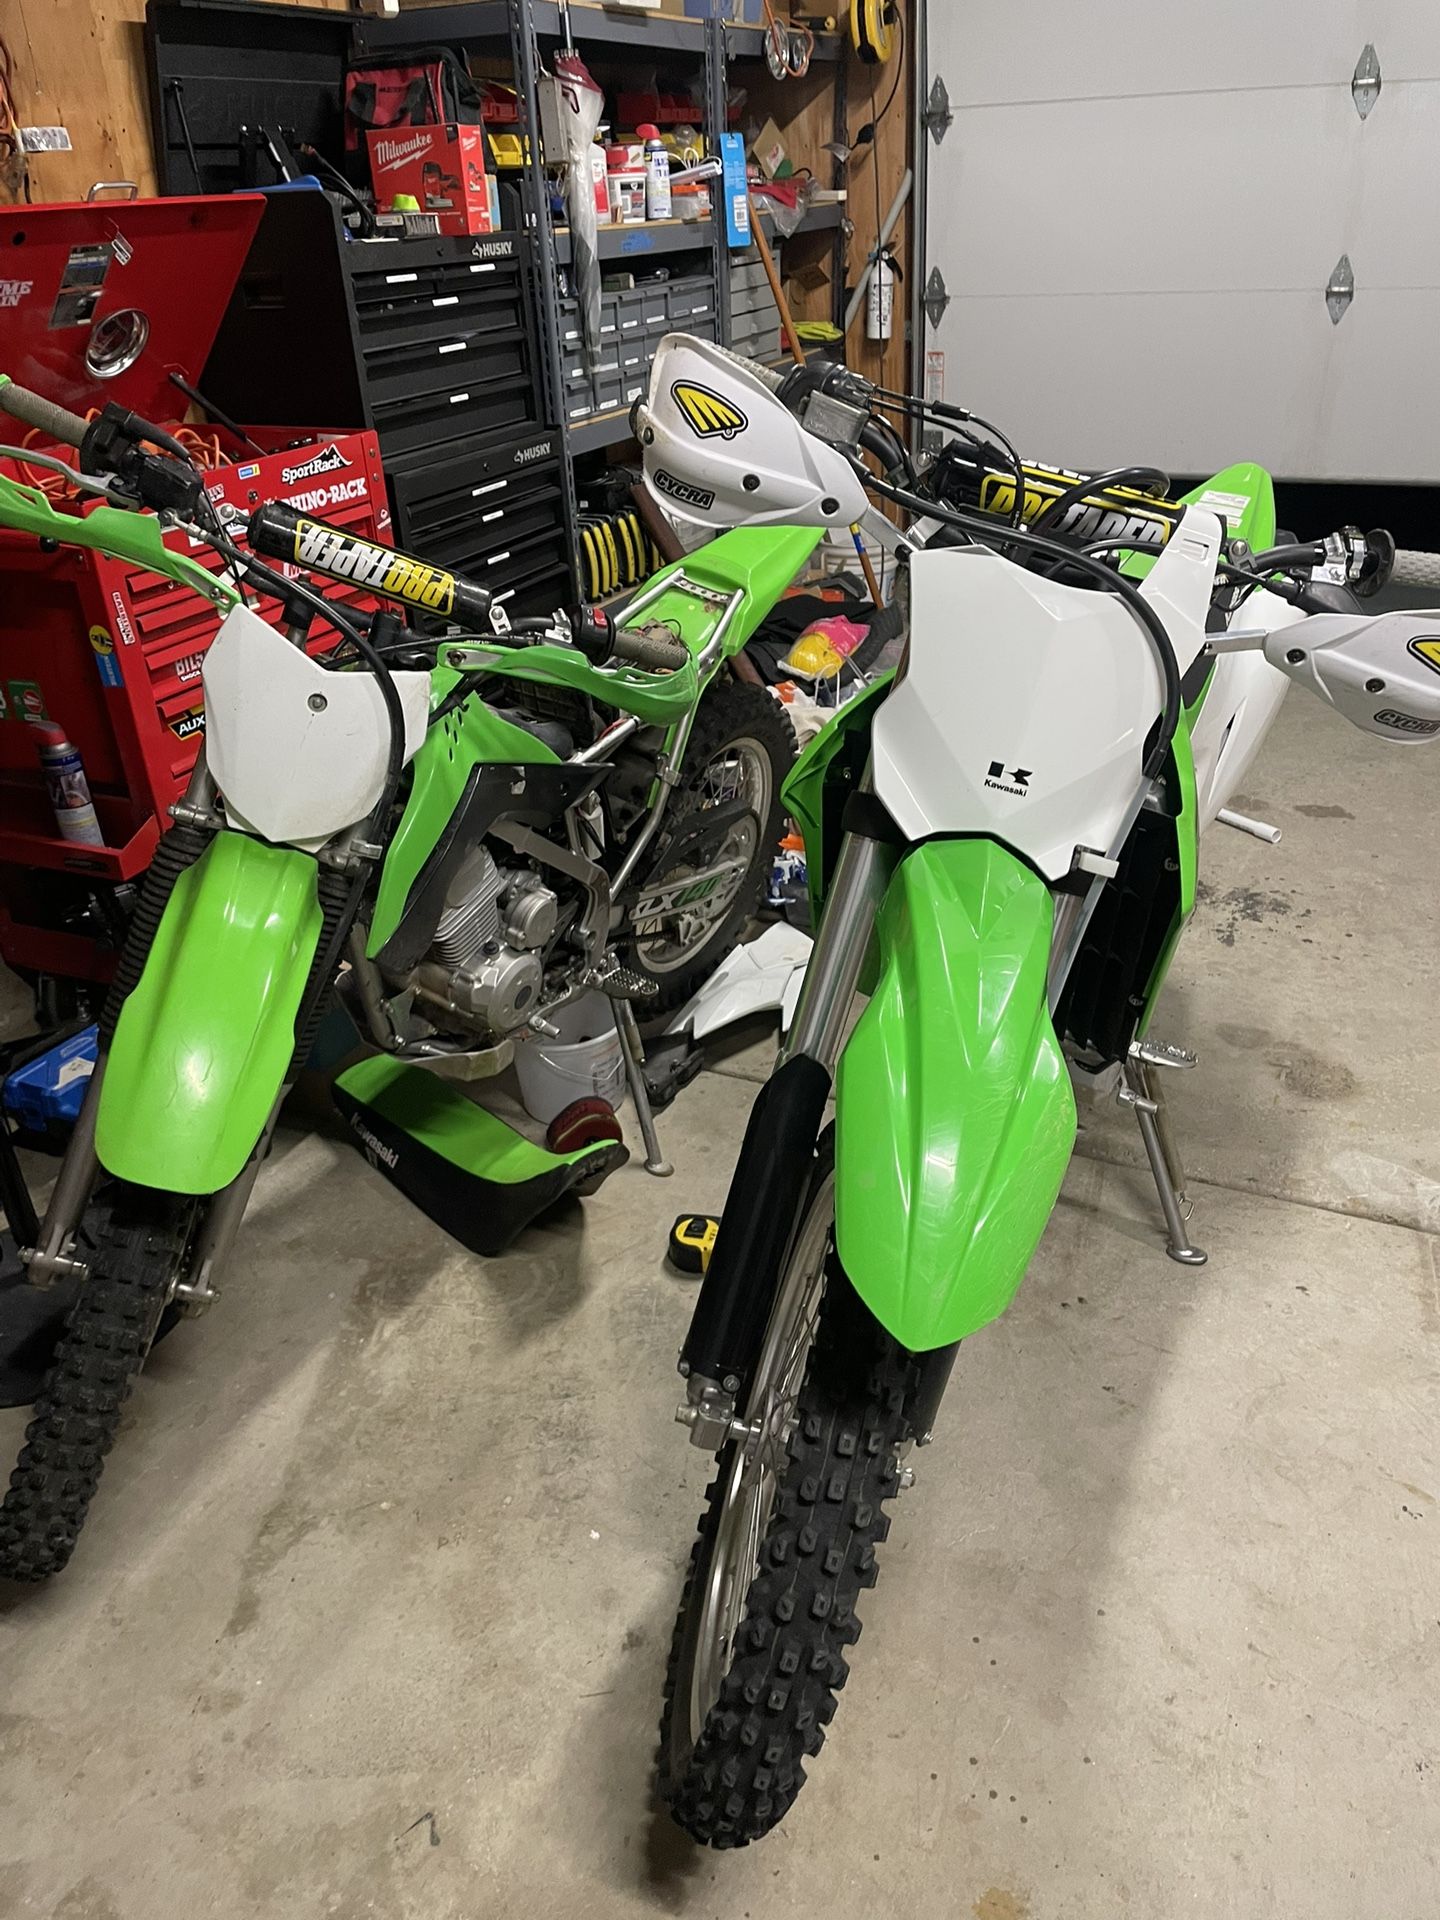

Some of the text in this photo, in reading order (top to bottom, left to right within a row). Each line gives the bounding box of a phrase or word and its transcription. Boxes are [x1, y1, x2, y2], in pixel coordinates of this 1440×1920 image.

[374, 132, 433, 165] Milwaukee
[483, 241, 513, 256] HUSKY
[523, 442, 551, 461] HUSKY
[282, 455, 341, 485] SportRack
[655, 471, 715, 509] CYCRA
[300, 524, 450, 608] PROTAPER
[179, 714, 206, 736] AUX
[983, 778, 1028, 797] Kawasaki
[350, 1111, 399, 1169] Kawasaki
